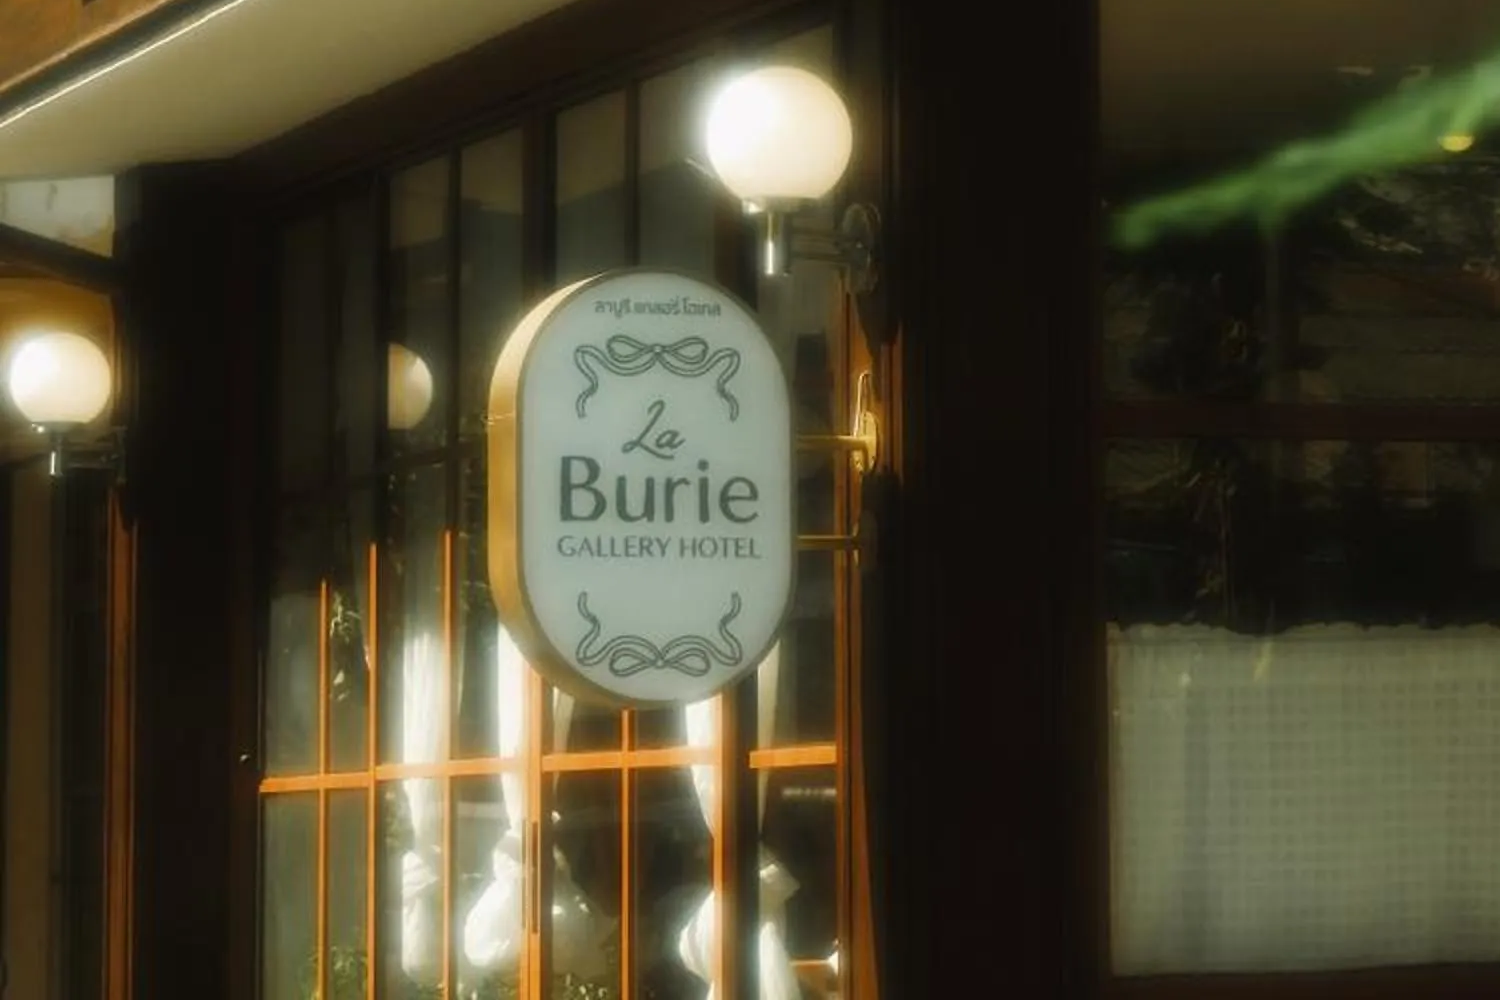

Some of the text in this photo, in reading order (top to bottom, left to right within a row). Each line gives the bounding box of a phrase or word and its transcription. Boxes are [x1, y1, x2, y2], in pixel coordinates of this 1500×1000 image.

[621, 400, 685, 459] La
[560, 456, 760, 523] Burie
[557, 535, 761, 560] GALLERY HOTEL
